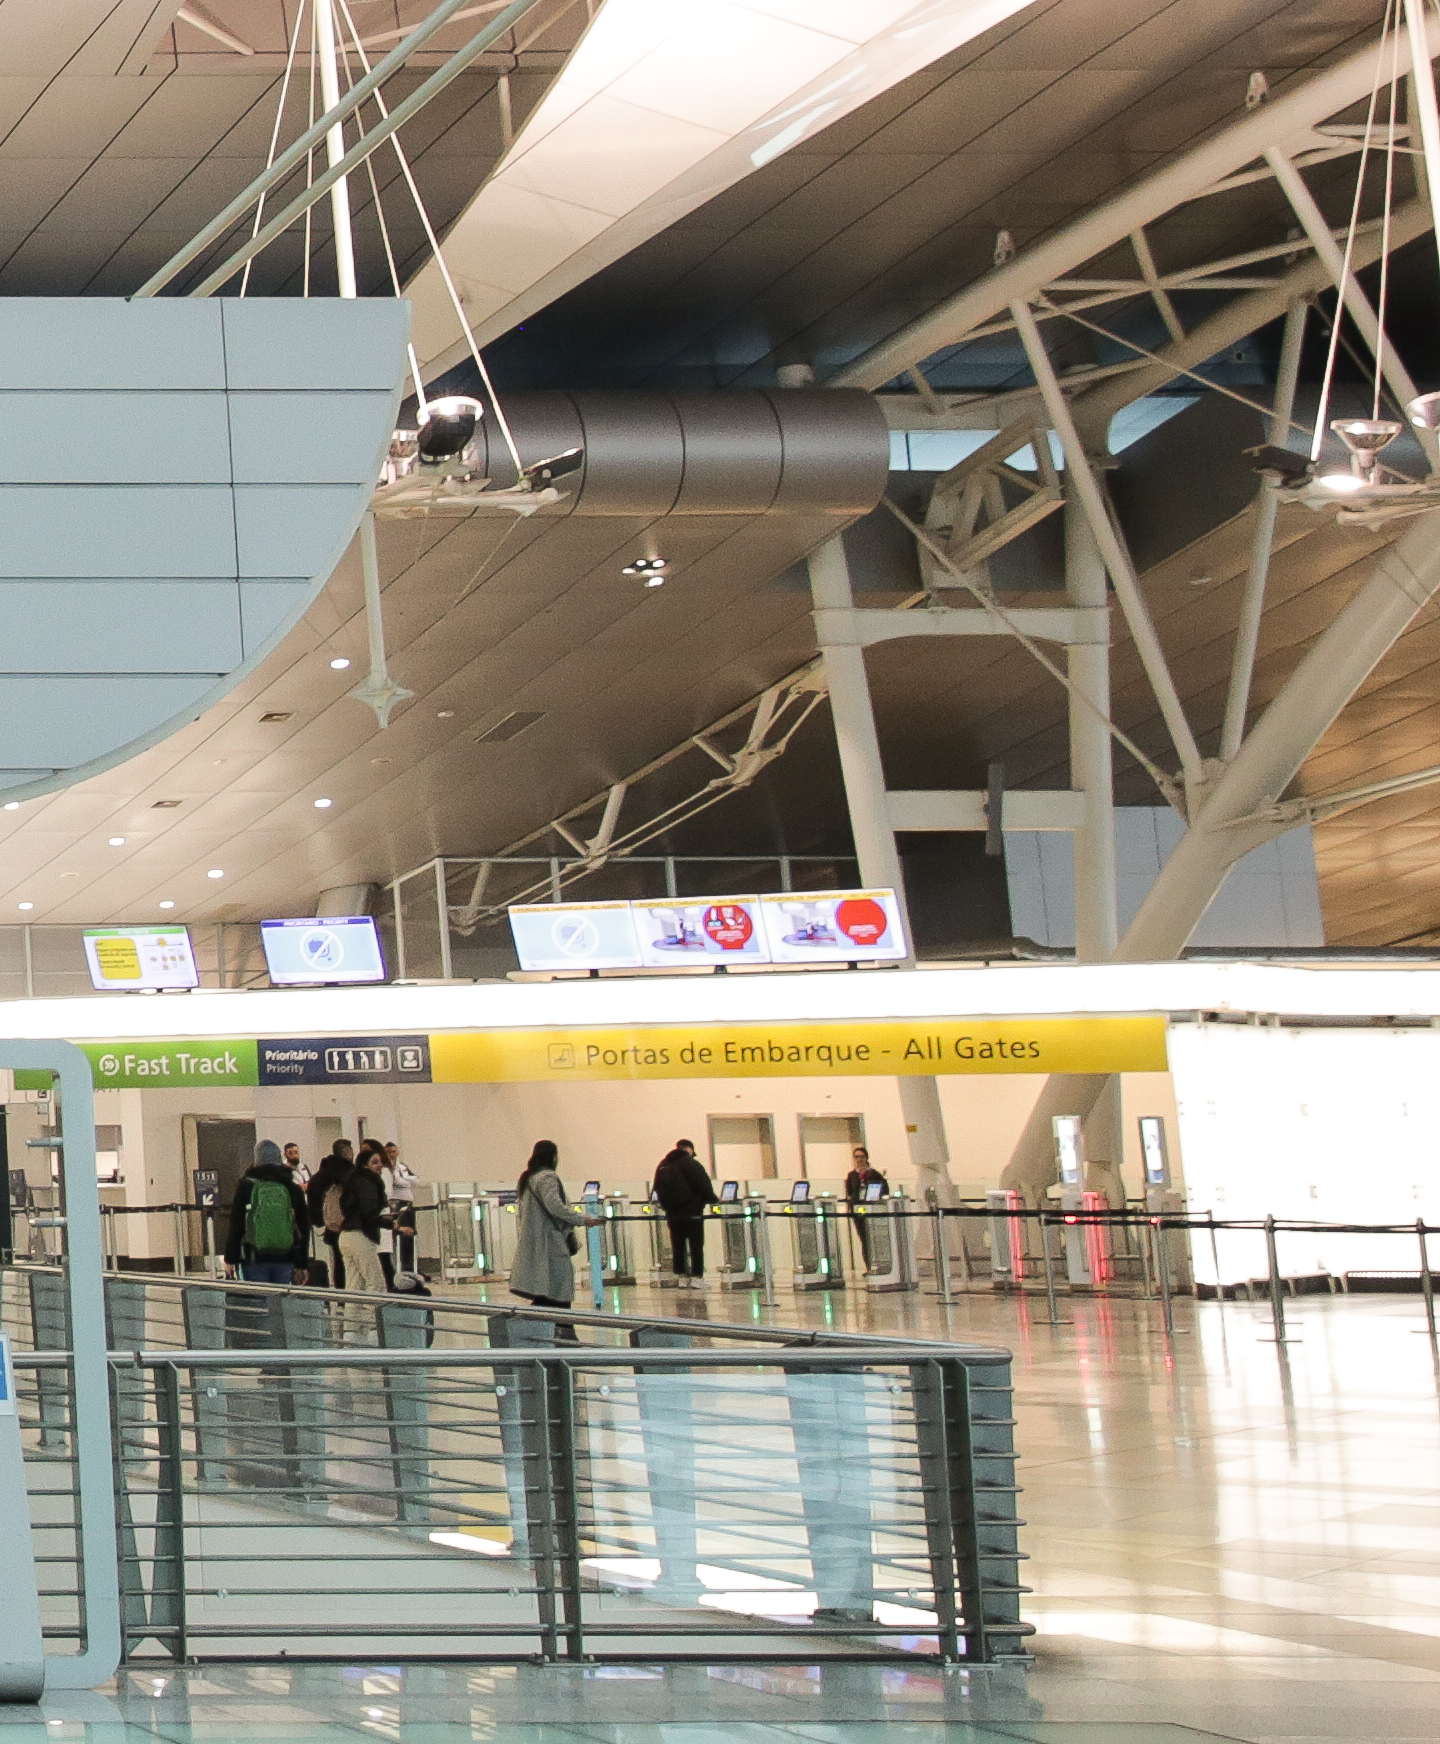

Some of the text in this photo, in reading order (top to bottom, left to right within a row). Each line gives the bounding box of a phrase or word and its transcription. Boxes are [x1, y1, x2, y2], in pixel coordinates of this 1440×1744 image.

[264, 1049, 319, 1062] Prioritário
[585, 1043, 670, 1067] Portas
[680, 1041, 713, 1064] de
[723, 1039, 871, 1068] Embarque
[903, 1036, 942, 1060] All
[954, 1036, 1041, 1060] Gates
[124, 1051, 239, 1076] Fast Track
[266, 1063, 305, 1076] Priority
